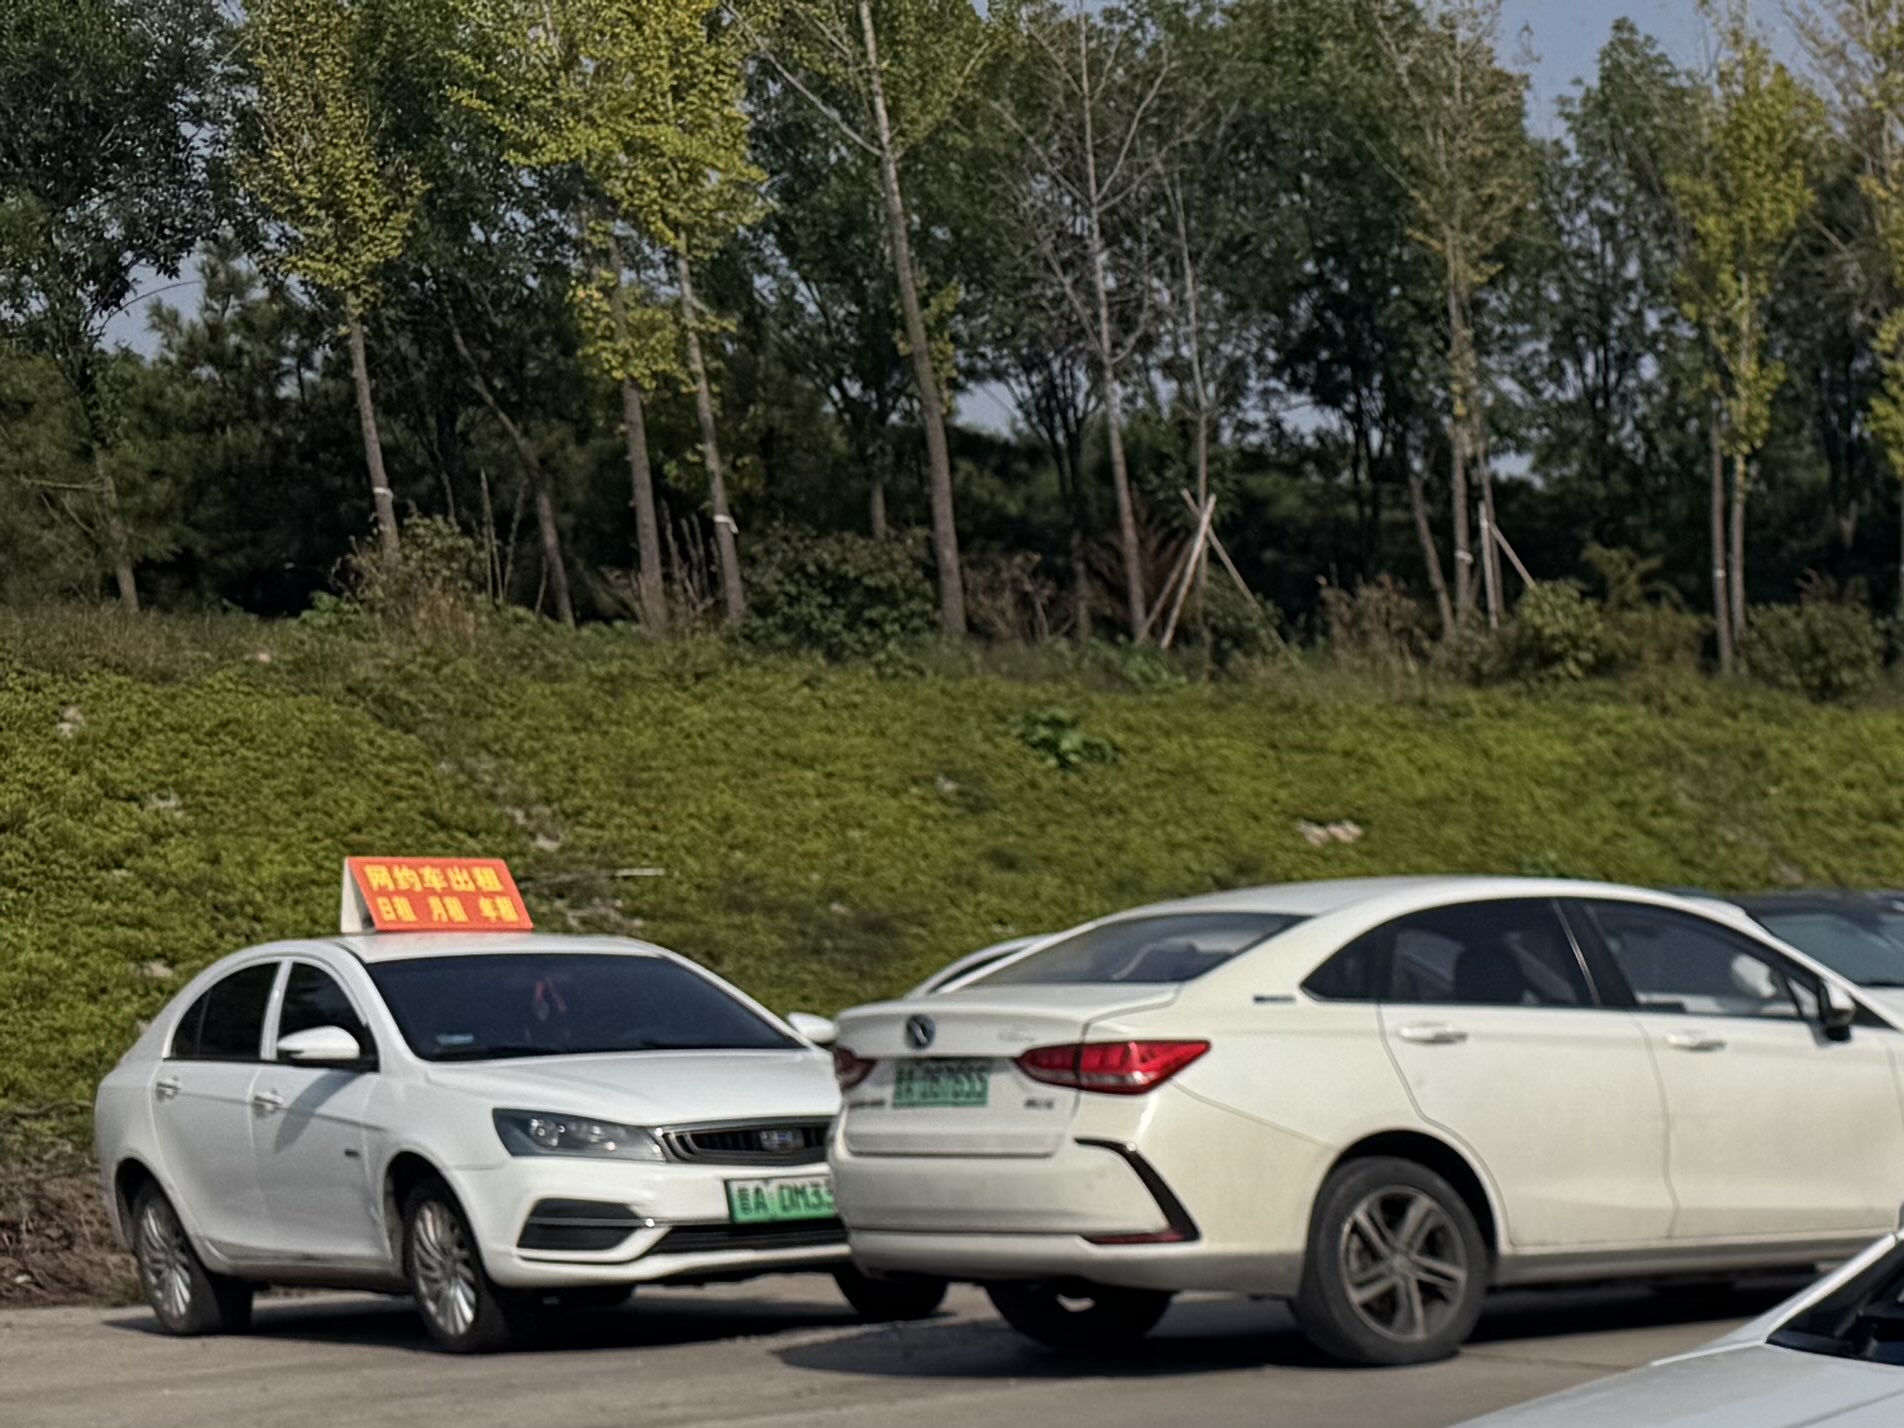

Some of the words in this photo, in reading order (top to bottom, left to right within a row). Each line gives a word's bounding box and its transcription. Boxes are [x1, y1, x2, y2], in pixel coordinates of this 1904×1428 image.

[363, 863, 503, 892] 网约车出租
[376, 896, 417, 923] 日租
[427, 895, 470, 923] 月租
[478, 896, 520, 923] 年租
